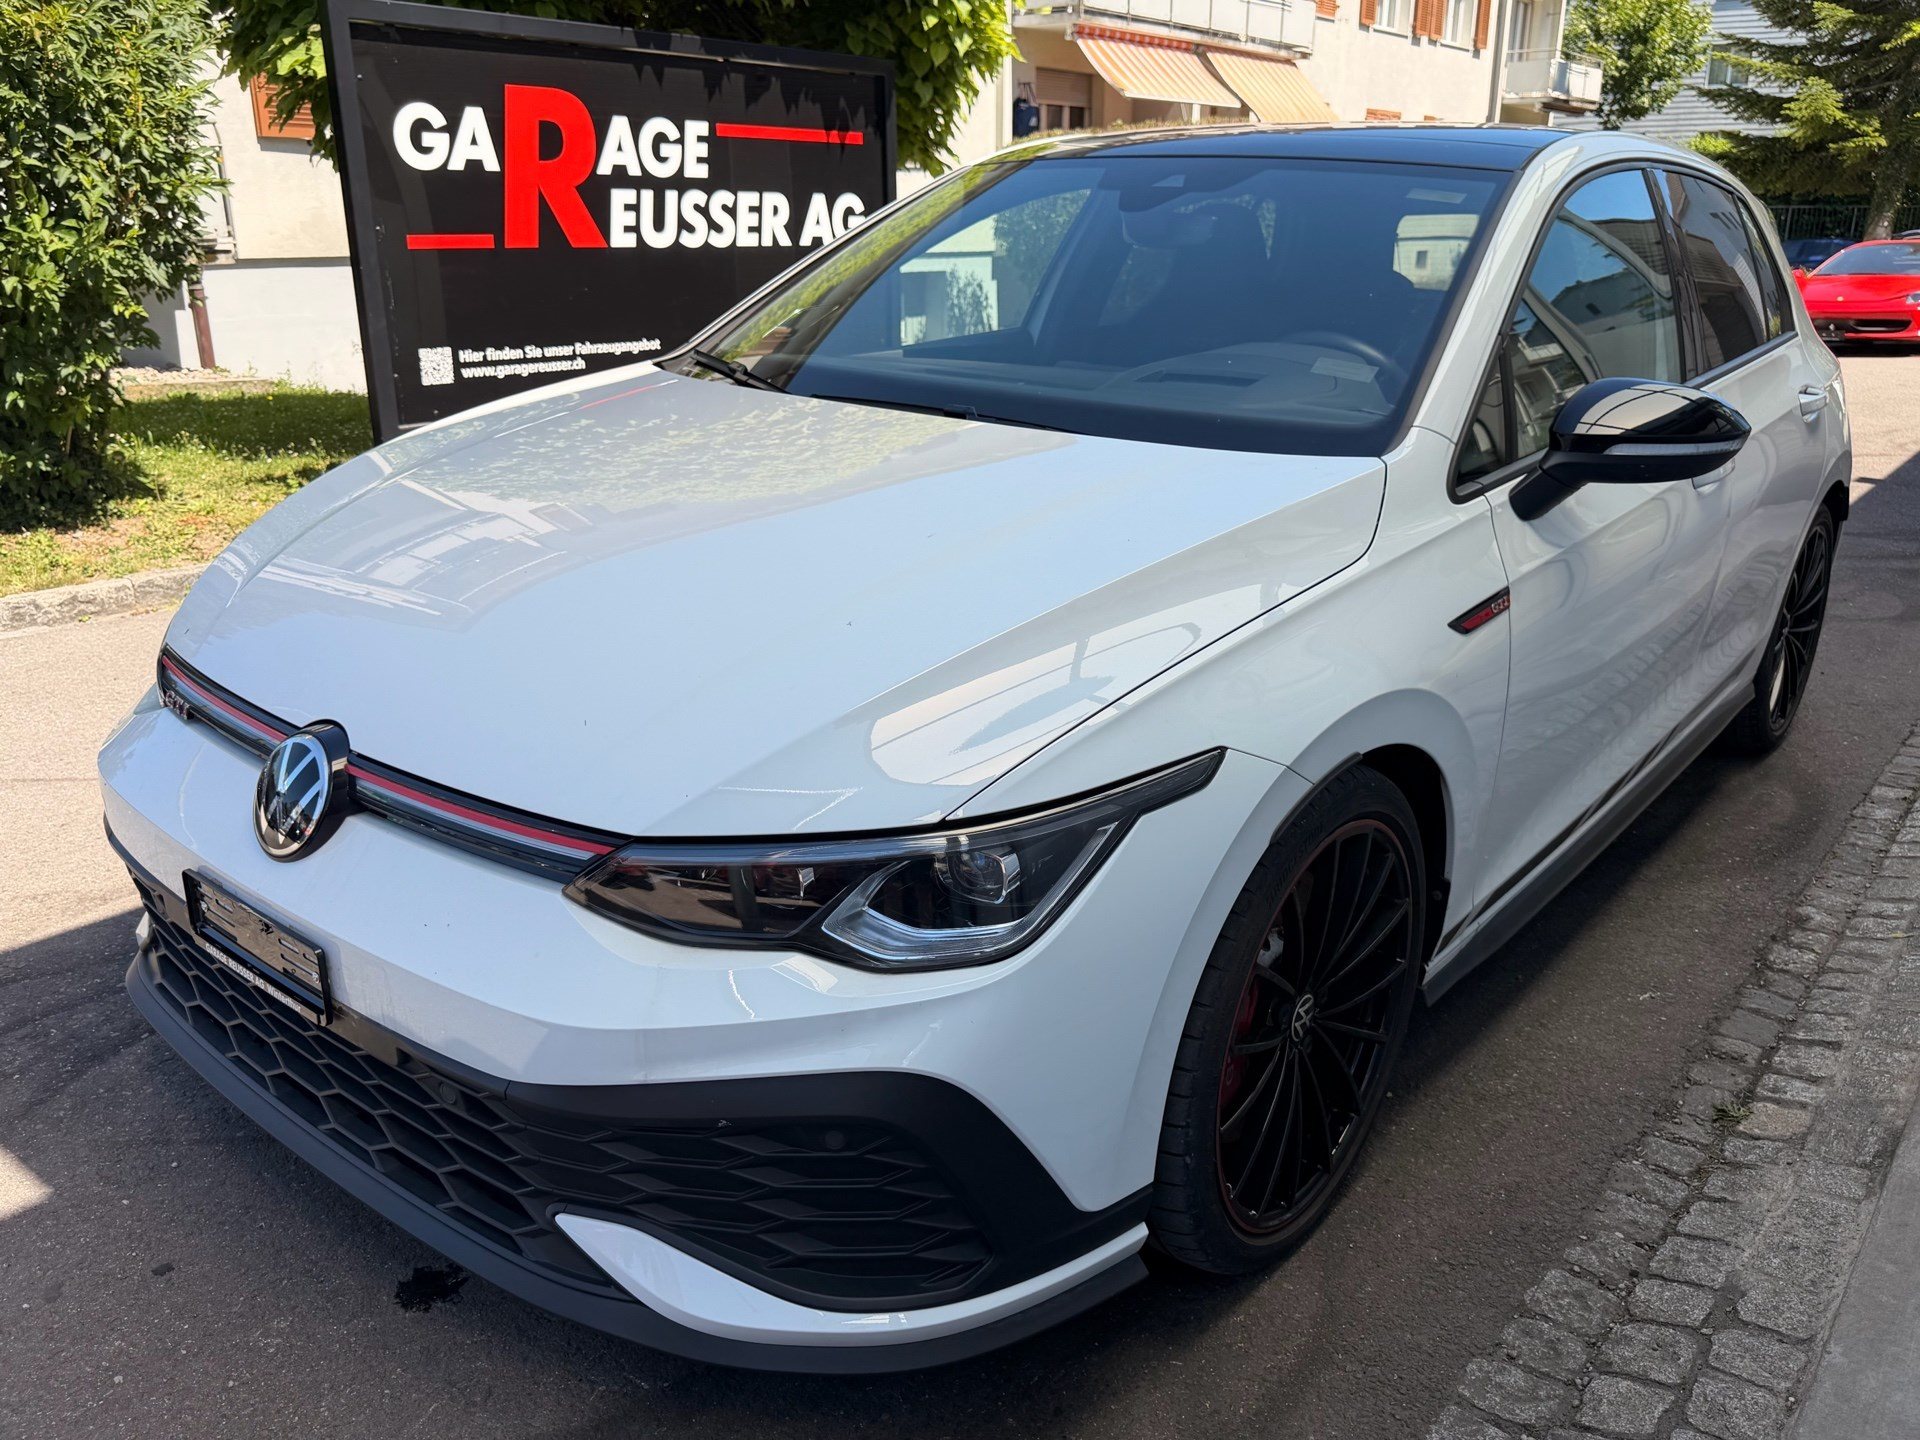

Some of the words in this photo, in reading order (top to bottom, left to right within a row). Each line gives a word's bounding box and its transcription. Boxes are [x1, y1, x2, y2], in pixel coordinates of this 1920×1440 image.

[393, 84, 709, 249] GARAGE
[799, 192, 866, 247] AG
[458, 350, 485, 363] Hier
[486, 346, 524, 361] finden
[524, 344, 543, 359] Sie
[543, 343, 574, 357] unser
[574, 338, 661, 357] Fahrzeugangebot
[461, 357, 585, 378] www.garagereusser.ch
[206, 943, 229, 965] GARAGE
[228, 961, 255, 984] REUSSER
[255, 976, 265, 989] AG
